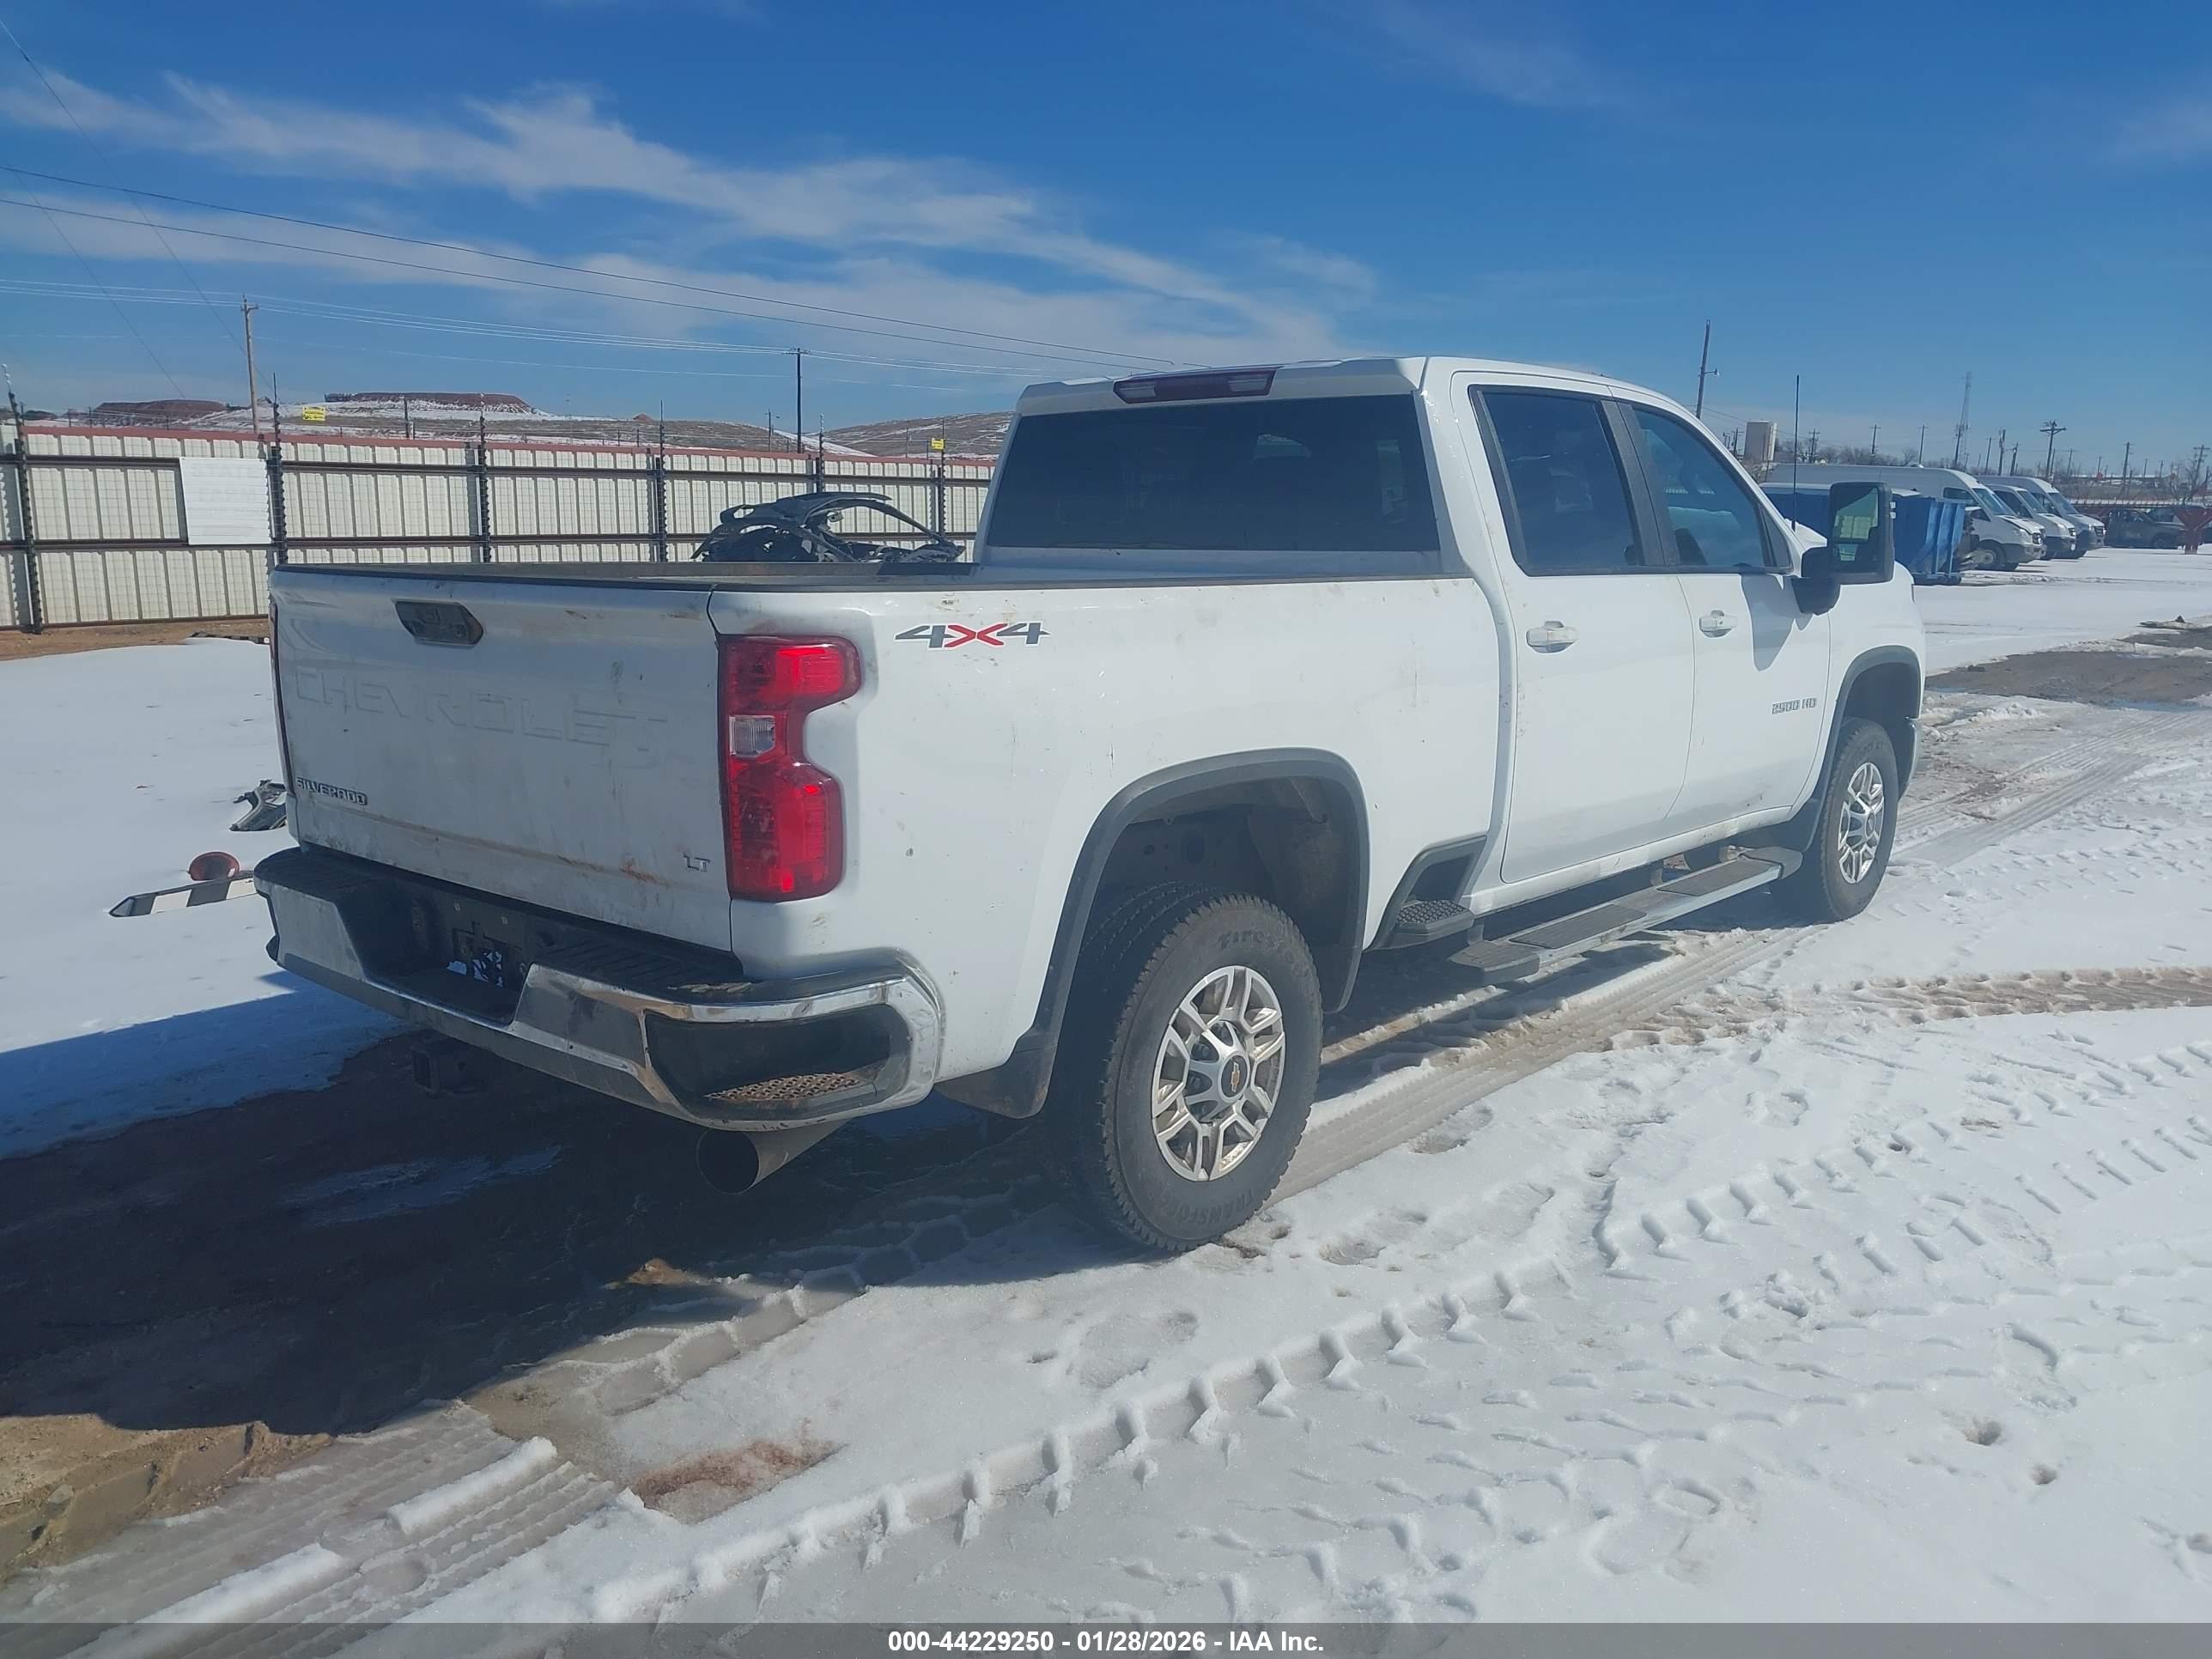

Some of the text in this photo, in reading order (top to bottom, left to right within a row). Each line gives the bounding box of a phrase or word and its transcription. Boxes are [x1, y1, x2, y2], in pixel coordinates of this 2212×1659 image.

[295, 668, 668, 752] CHEVROLET
[1771, 696, 1818, 715] 2500 HD
[295, 776, 368, 806] SILVERADO
[682, 851, 712, 873] LT
